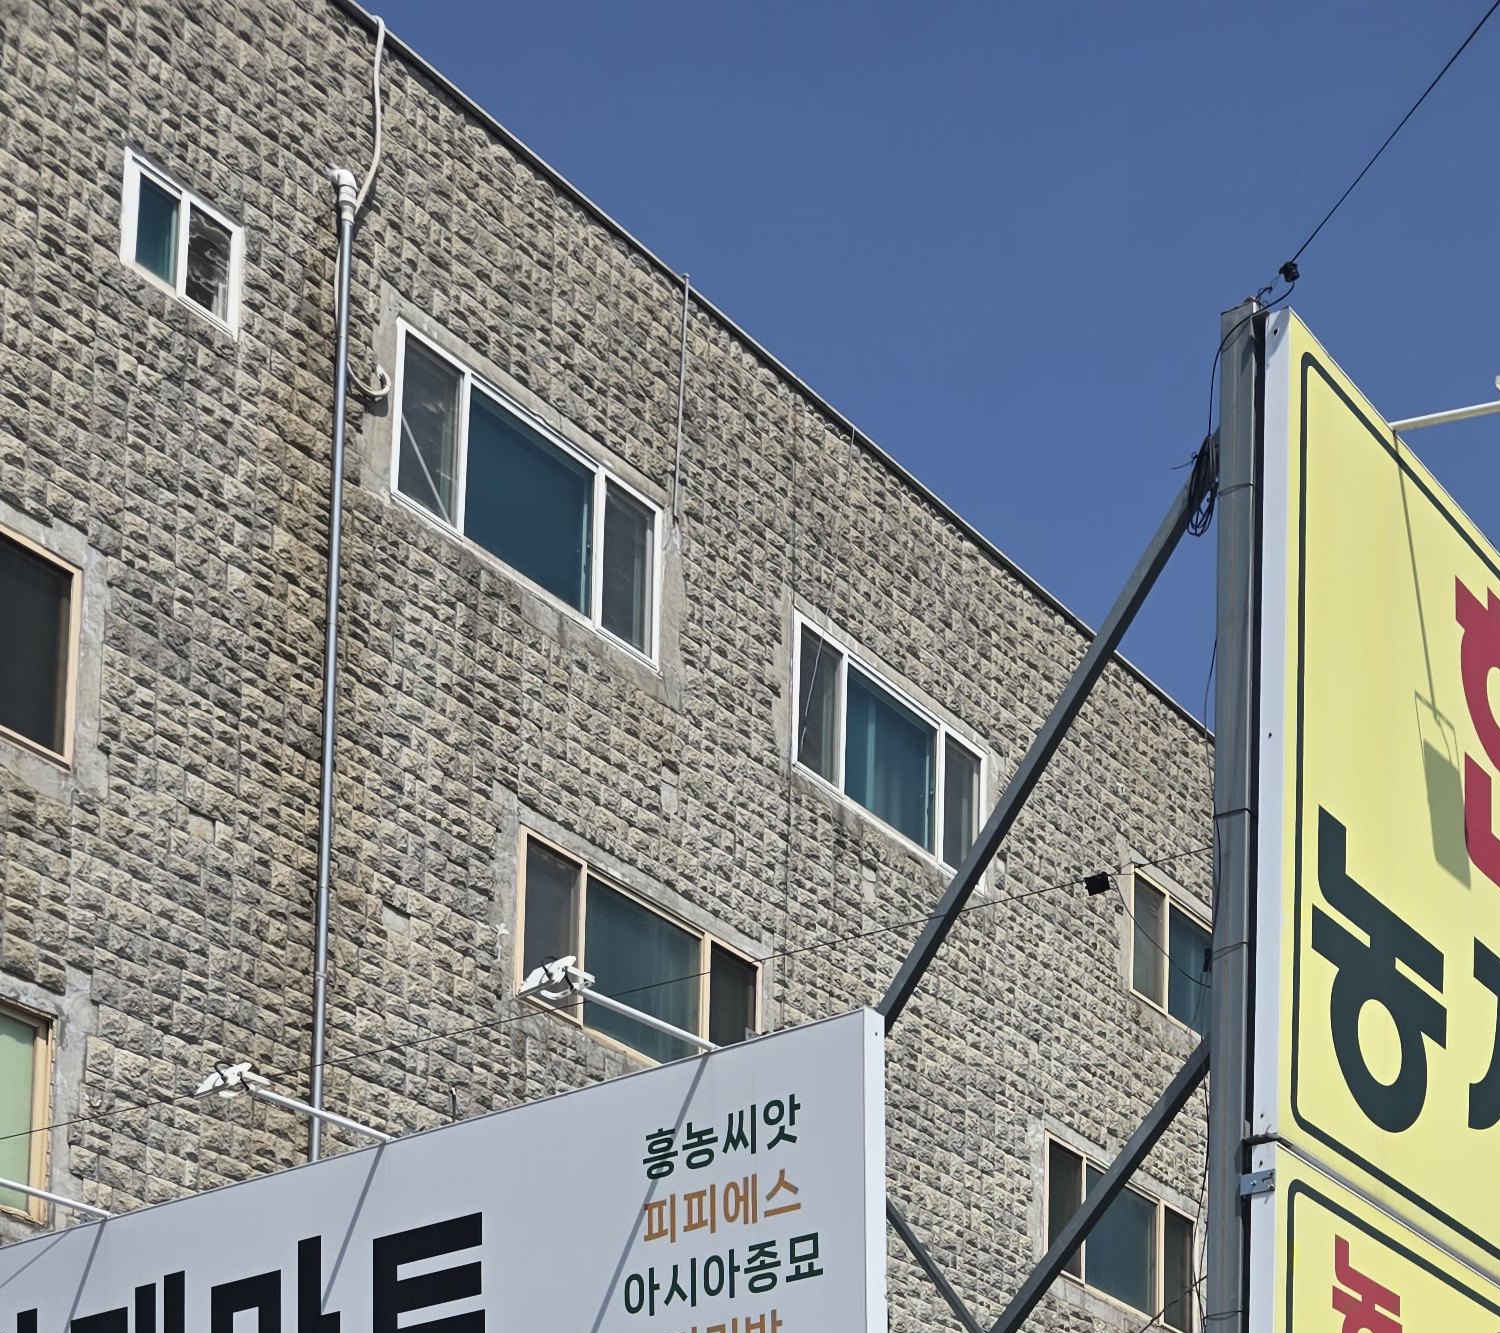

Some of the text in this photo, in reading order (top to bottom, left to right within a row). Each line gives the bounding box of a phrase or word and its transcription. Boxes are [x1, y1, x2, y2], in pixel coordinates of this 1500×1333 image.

[643, 1094, 801, 1180] 흥농씨앗
[643, 1168, 801, 1243] 피피에스
[624, 1232, 824, 1317] 아시아종묘
